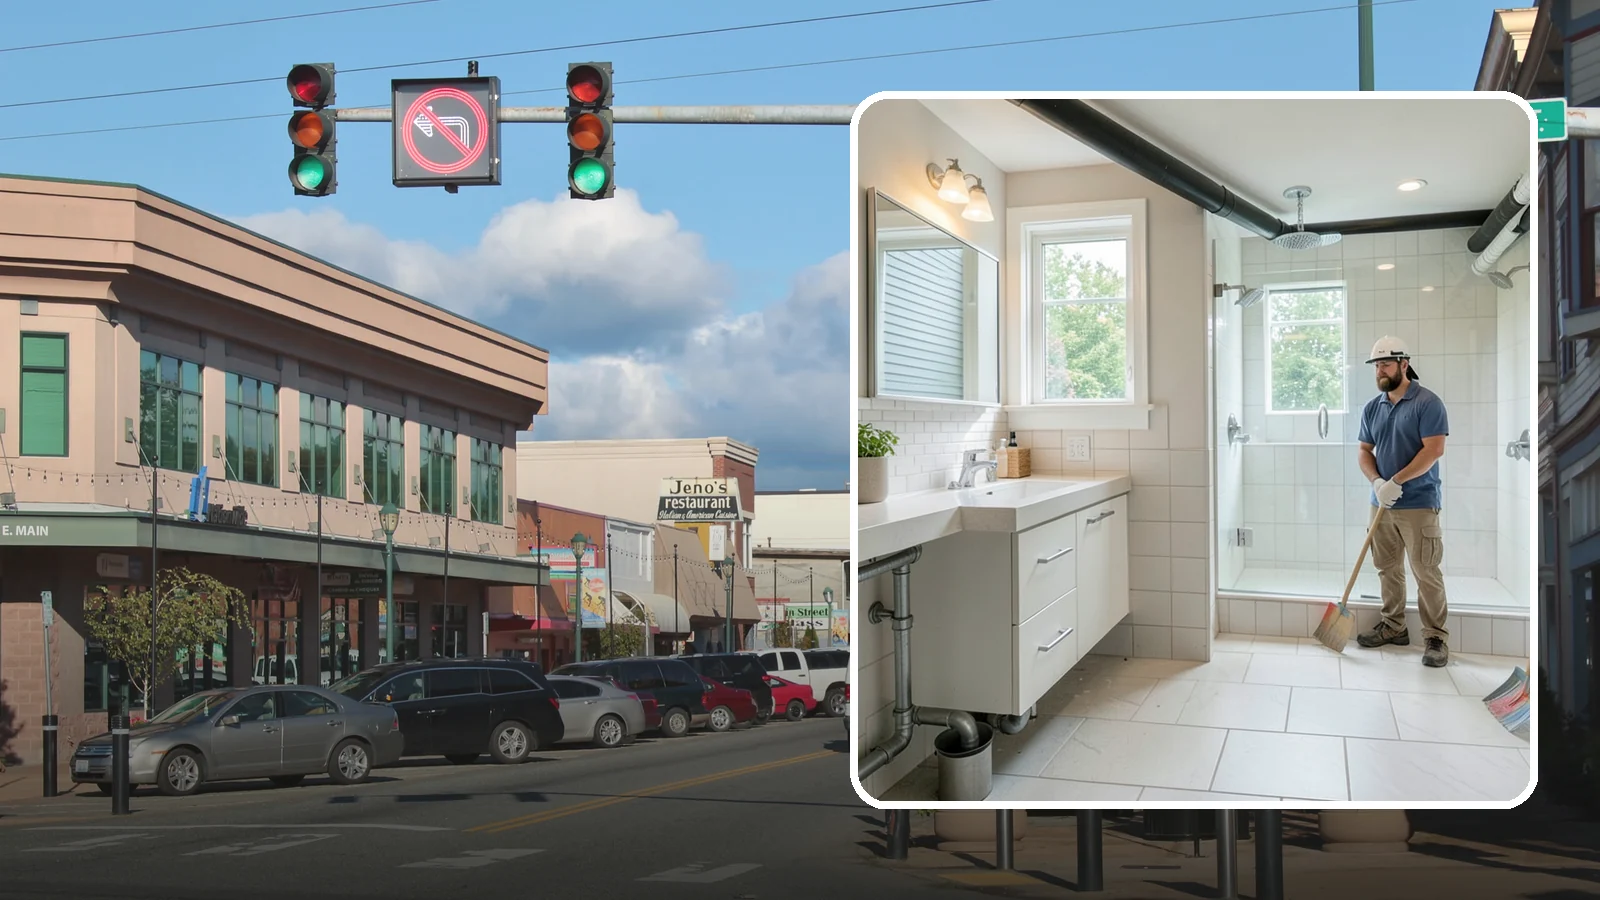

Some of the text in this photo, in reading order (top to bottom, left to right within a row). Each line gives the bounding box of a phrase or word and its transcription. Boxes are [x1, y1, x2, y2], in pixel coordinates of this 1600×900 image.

[670, 480, 727, 494] Jeno's
[665, 496, 731, 509] restaurant
[659, 510, 682, 519] Italian
[686, 510, 714, 519] American
[715, 510, 737, 519] Cuisine
[2, 525, 49, 537] E. MAIN
[797, 607, 828, 617] Street
